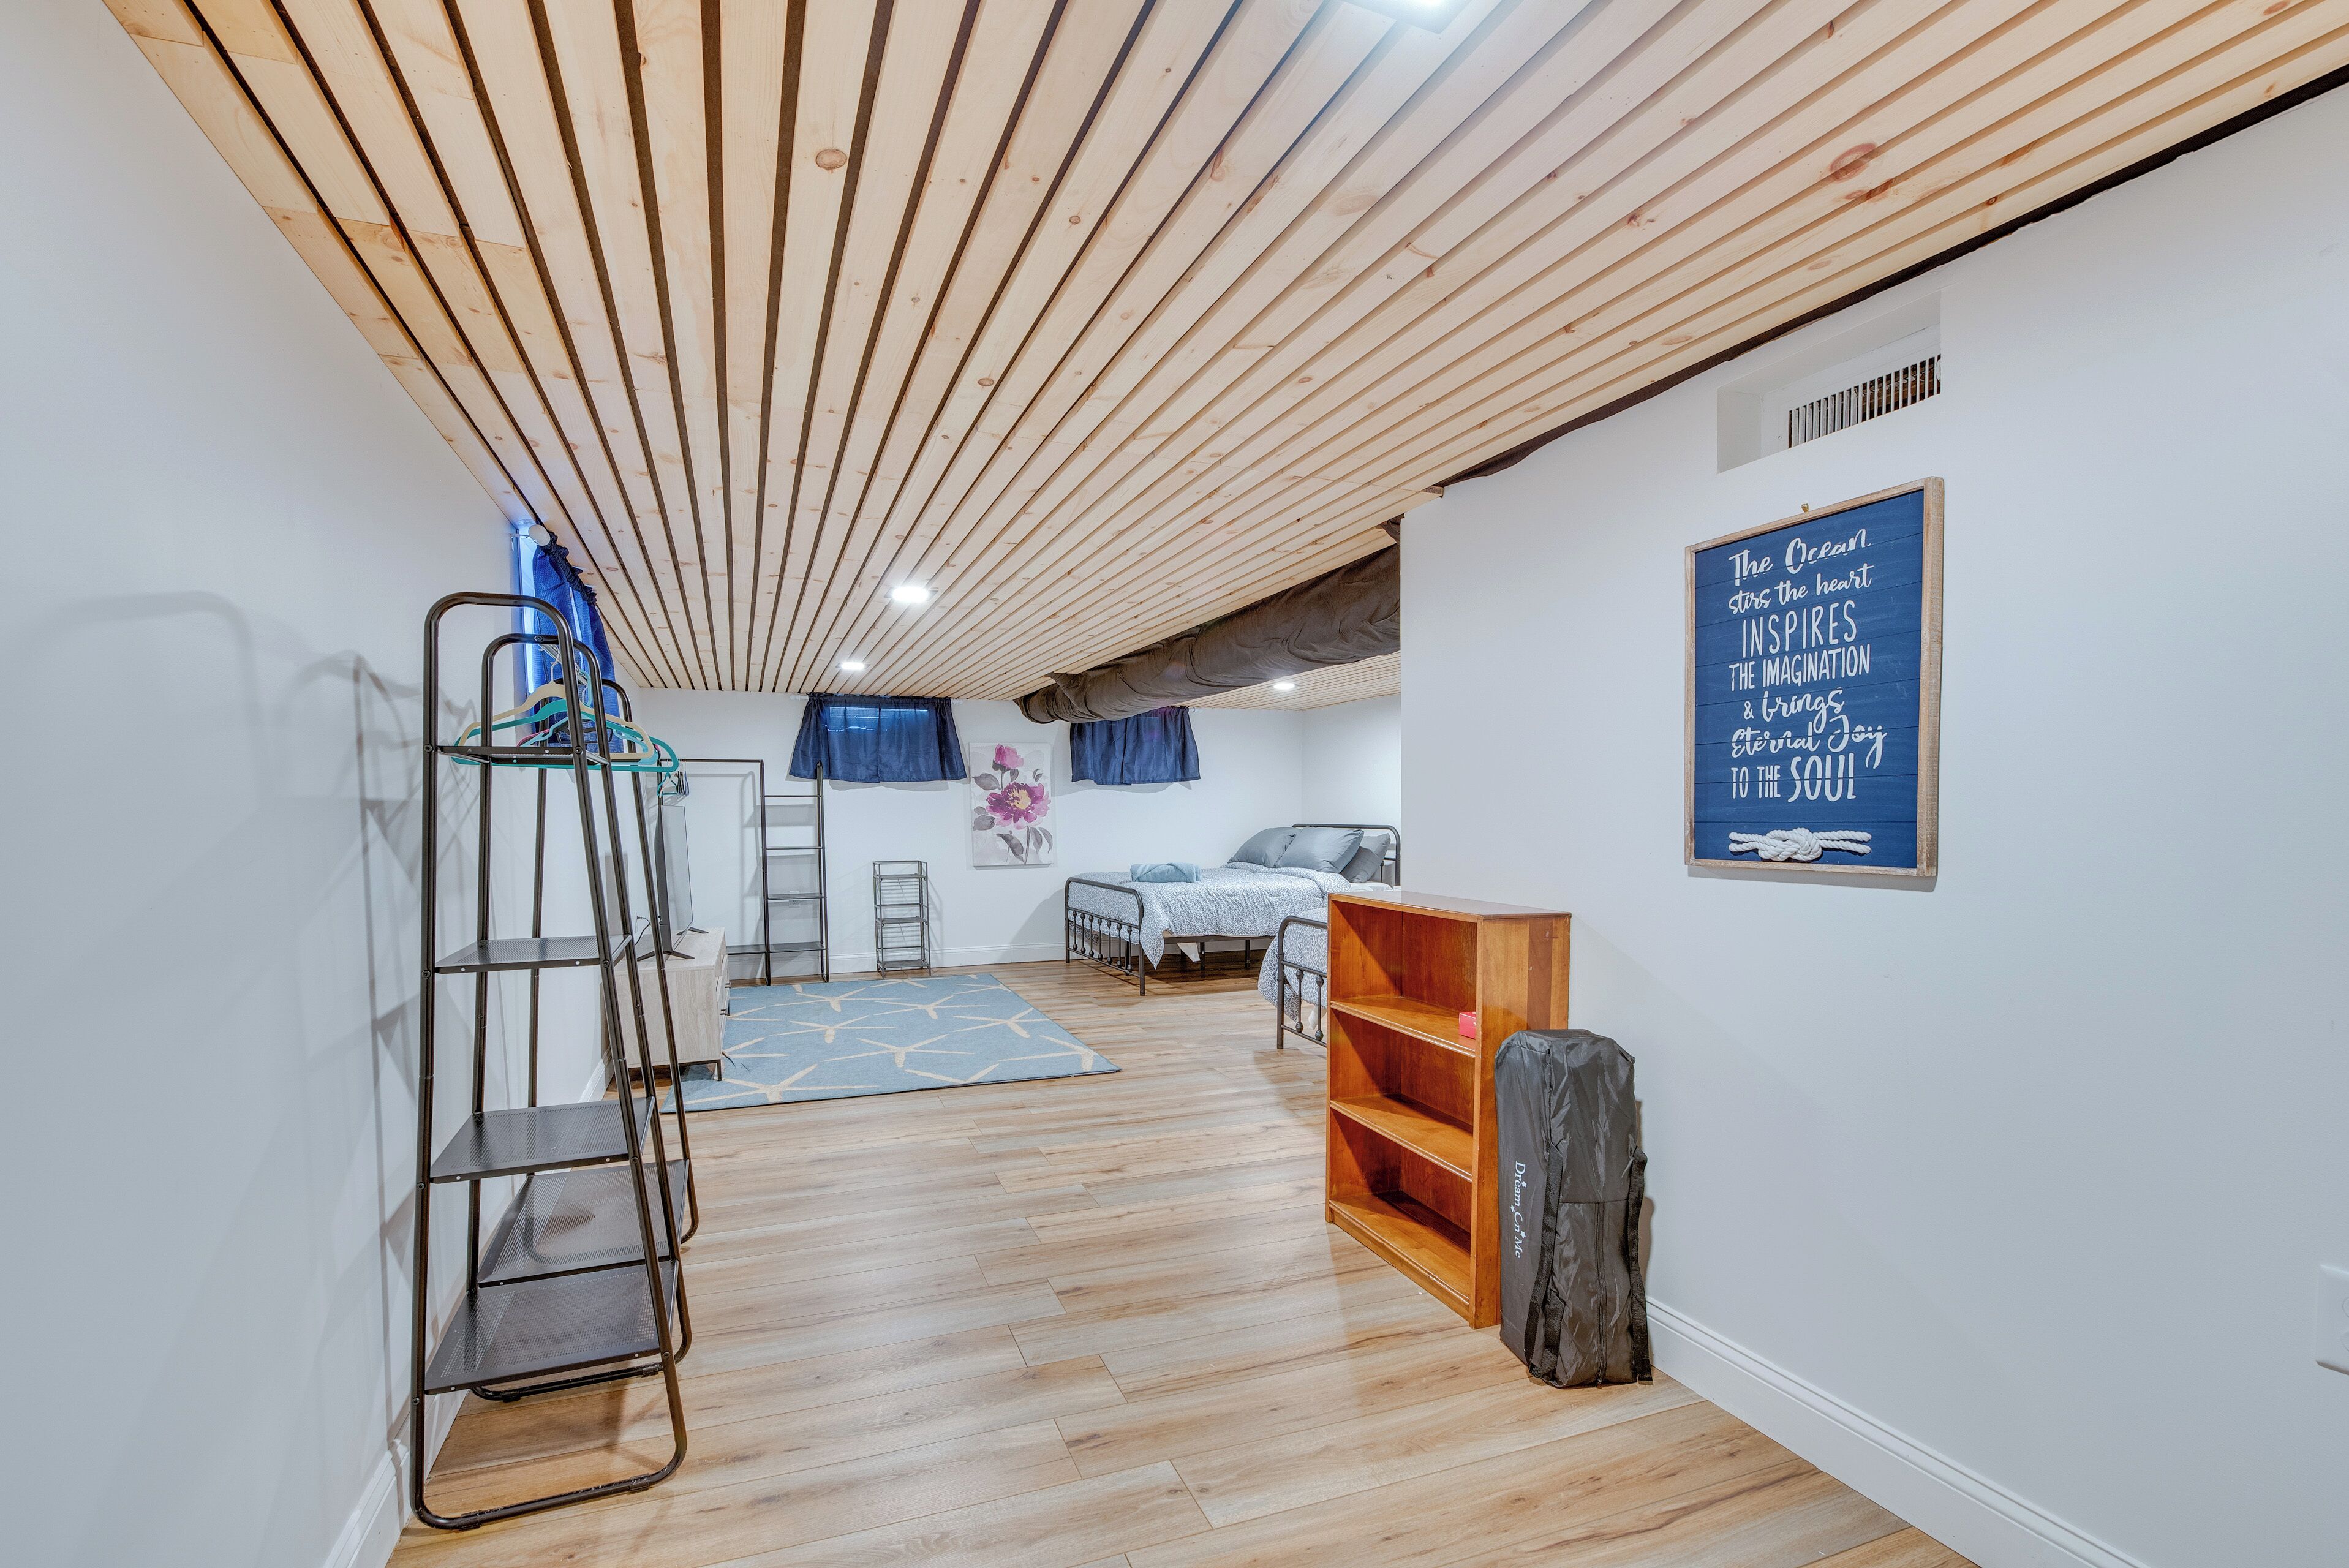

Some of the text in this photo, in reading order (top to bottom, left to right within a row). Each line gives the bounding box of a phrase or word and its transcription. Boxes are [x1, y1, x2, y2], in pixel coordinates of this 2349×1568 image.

[1728, 529, 1872, 587] The Ocean
[1729, 563, 1874, 614] stirs the heart
[1742, 600, 1857, 659] INSPIRES
[1729, 644, 1870, 692] THE IMAGINATION
[1743, 687, 1844, 734] & brings
[1827, 714, 1888, 769] Joy
[1731, 752, 1857, 802] TO THE SOUL
[1514, 1161, 1526, 1207] Dream
[1514, 1235, 1523, 1258] Me
